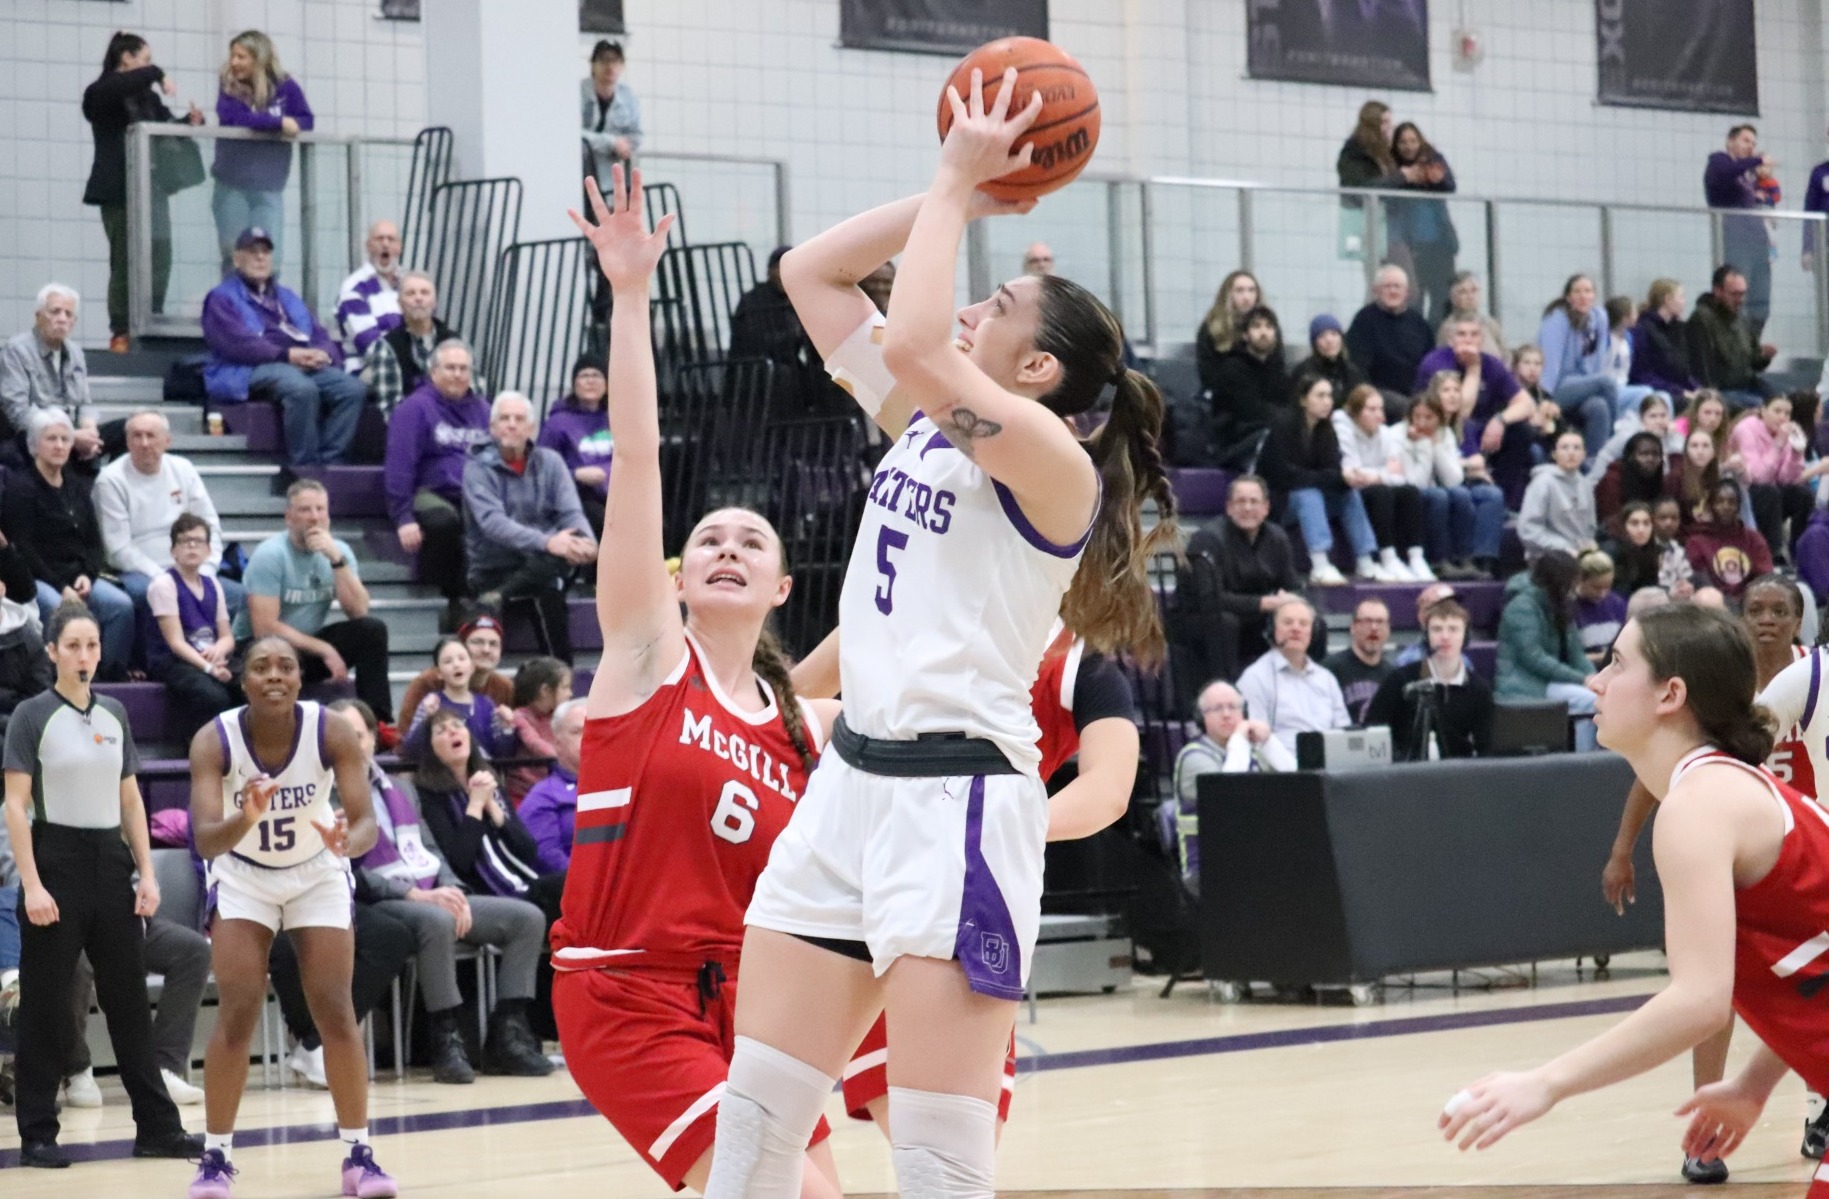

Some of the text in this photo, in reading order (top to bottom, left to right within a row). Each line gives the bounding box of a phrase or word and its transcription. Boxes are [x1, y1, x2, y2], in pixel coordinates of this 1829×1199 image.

[874, 524, 909, 617] 5
[233, 783, 317, 812] GTERS
[710, 779, 760, 845] 6
[258, 816, 296, 853] 15
